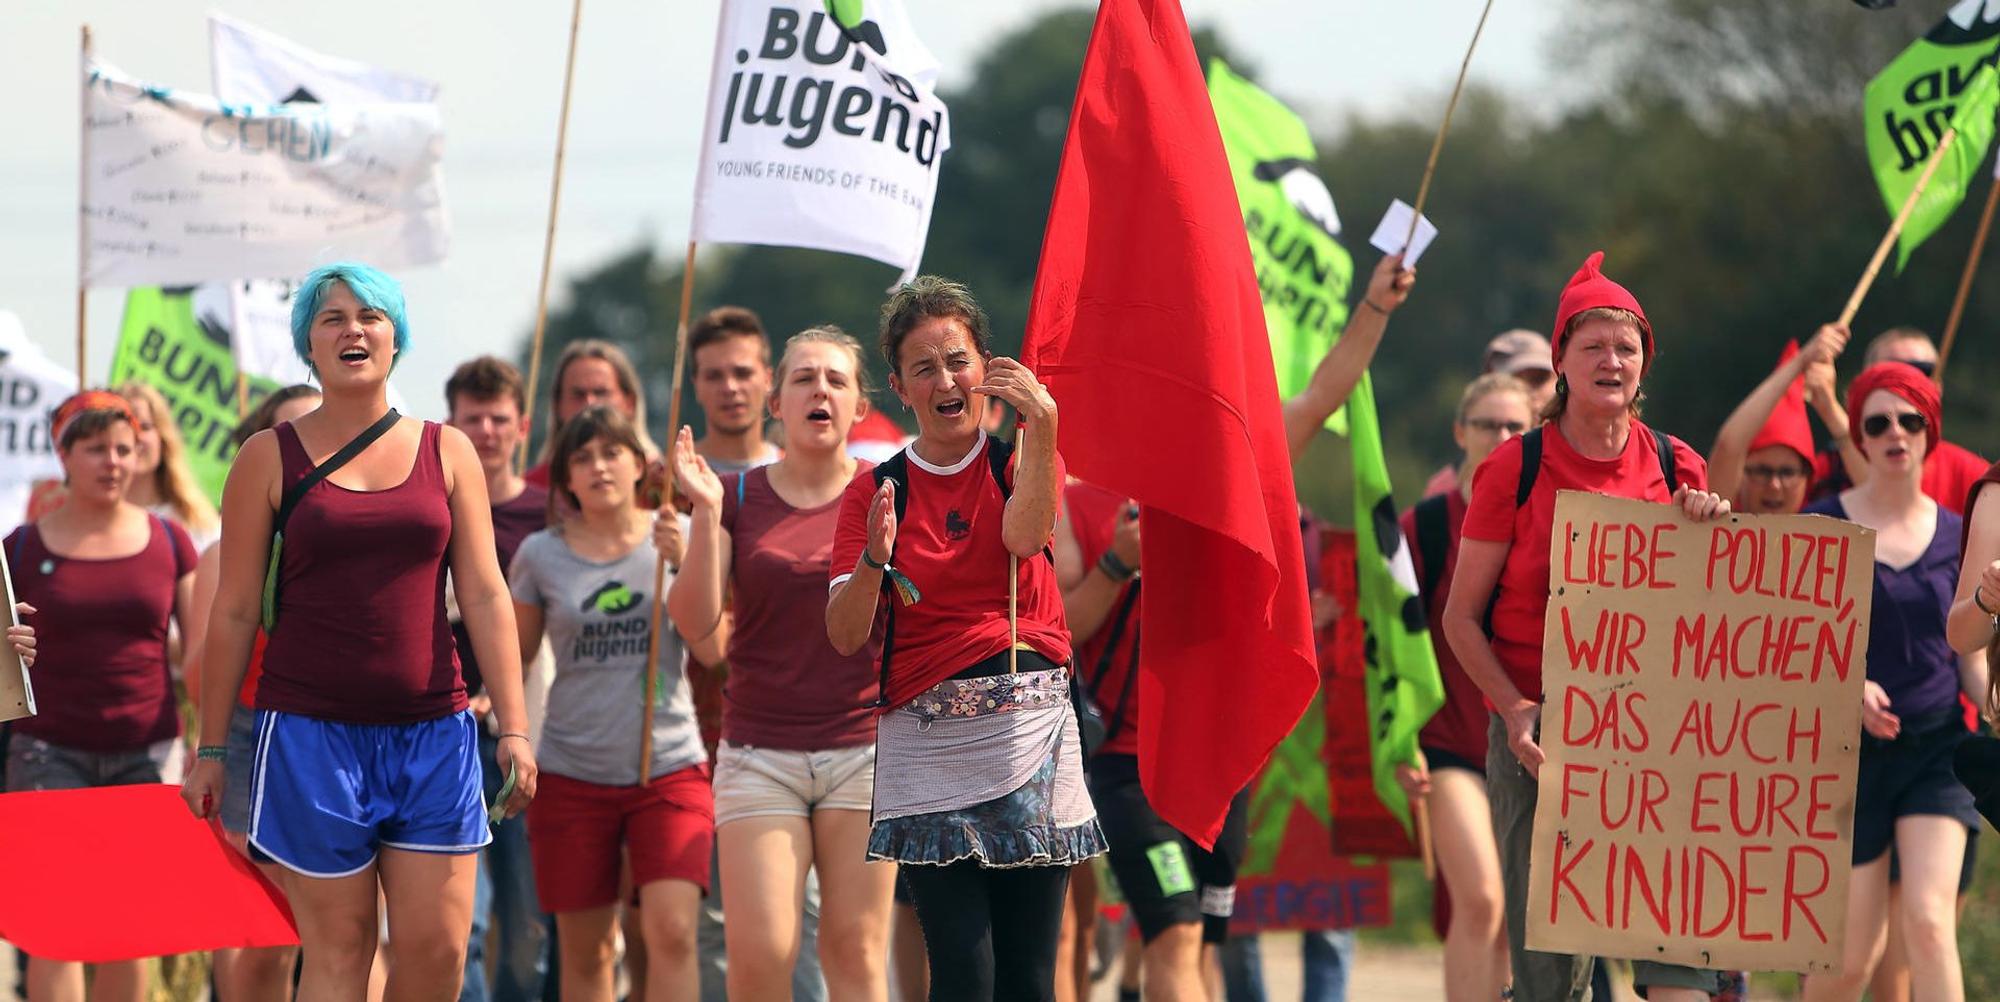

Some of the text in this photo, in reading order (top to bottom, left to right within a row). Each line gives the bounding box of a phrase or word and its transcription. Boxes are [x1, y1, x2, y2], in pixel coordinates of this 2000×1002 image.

[719, 49, 942, 170] jugend
[717, 160, 762, 178] YOUNG
[766, 162, 835, 187] FRIENDS
[841, 173, 861, 190] OF
[869, 178, 897, 200] THE
[1563, 521, 1855, 623] LIEBE POLIZEI,
[583, 617, 647, 638] BUND
[1561, 606, 1857, 683] WIR MACHEN
[1562, 685, 1822, 764] DAS AUCH
[1560, 760, 1841, 840] FÜR EURE
